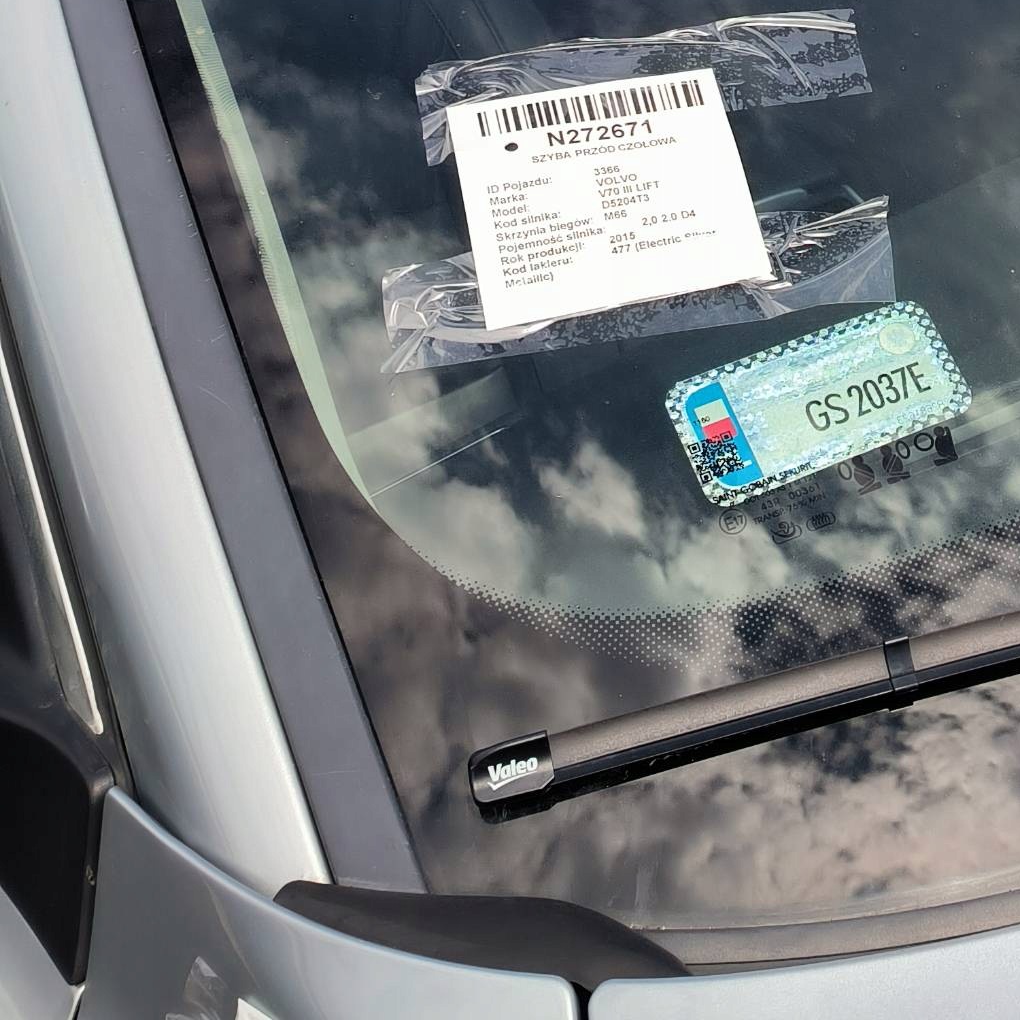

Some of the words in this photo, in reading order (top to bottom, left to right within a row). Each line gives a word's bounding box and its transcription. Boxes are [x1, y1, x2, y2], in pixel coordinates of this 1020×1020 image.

[547, 119, 653, 147] N272671
[531, 151, 572, 164] SZYBA
[575, 144, 616, 157] PRZÓD
[618, 136, 677, 151] CZOŁOWA
[487, 184, 500, 194] ID
[503, 176, 553, 191] Pojazdu:
[593, 165, 620, 176] 3366
[489, 192, 528, 206] Marka:
[595, 173, 638, 187] VOLVO
[491, 204, 530, 218] Model:
[598, 187, 620, 198] V70
[623, 185, 633, 194] III
[636, 181, 660, 192] LIFT
[494, 218, 518, 229] Kod
[521, 211, 561, 225] silnika:
[601, 194, 650, 209] D5204T3
[496, 227, 546, 242] Skrzynia
[549, 217, 593, 232] biegów:
[604, 209, 628, 221] M66
[498, 234, 563, 254] Pojemność
[566, 226, 606, 241] silnika:
[642, 216, 658, 226] 2,0
[661, 212, 677, 223] 2.0
[681, 209, 696, 219] D4
[500, 254, 524, 266] Rok
[527, 241, 585, 261] produkcji:
[609, 231, 636, 244] 2015
[503, 264, 527, 277] Kod
[530, 256, 573, 272] lakieru:
[611, 244, 631, 254] 477
[635, 235, 682, 252] (Electric
[805, 393, 850, 432] GS
[846, 361, 932, 417] 2037E
[723, 515, 744, 531] E17
[487, 757, 539, 783] Valeo
